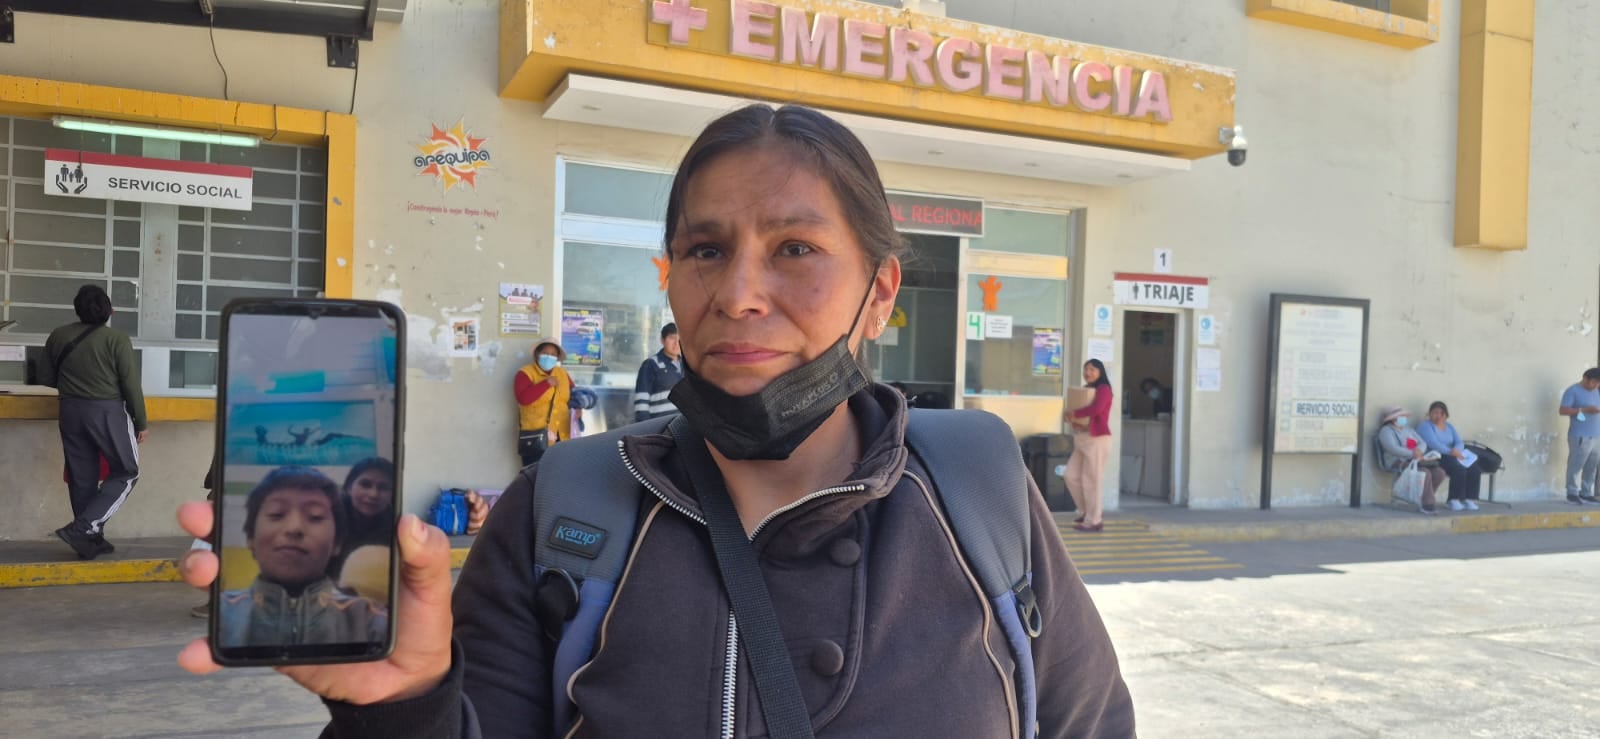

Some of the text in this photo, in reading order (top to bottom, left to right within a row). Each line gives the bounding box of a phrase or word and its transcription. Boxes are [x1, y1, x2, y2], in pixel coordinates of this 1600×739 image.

[730, 0, 1173, 122] EMERGENCIA
[414, 148, 490, 167] arequipa
[108, 177, 243, 199] SERVICIO SOCIAL
[1160, 252, 1166, 267] 1
[1144, 283, 1194, 304] TRIAJE
[968, 314, 981, 337] 4
